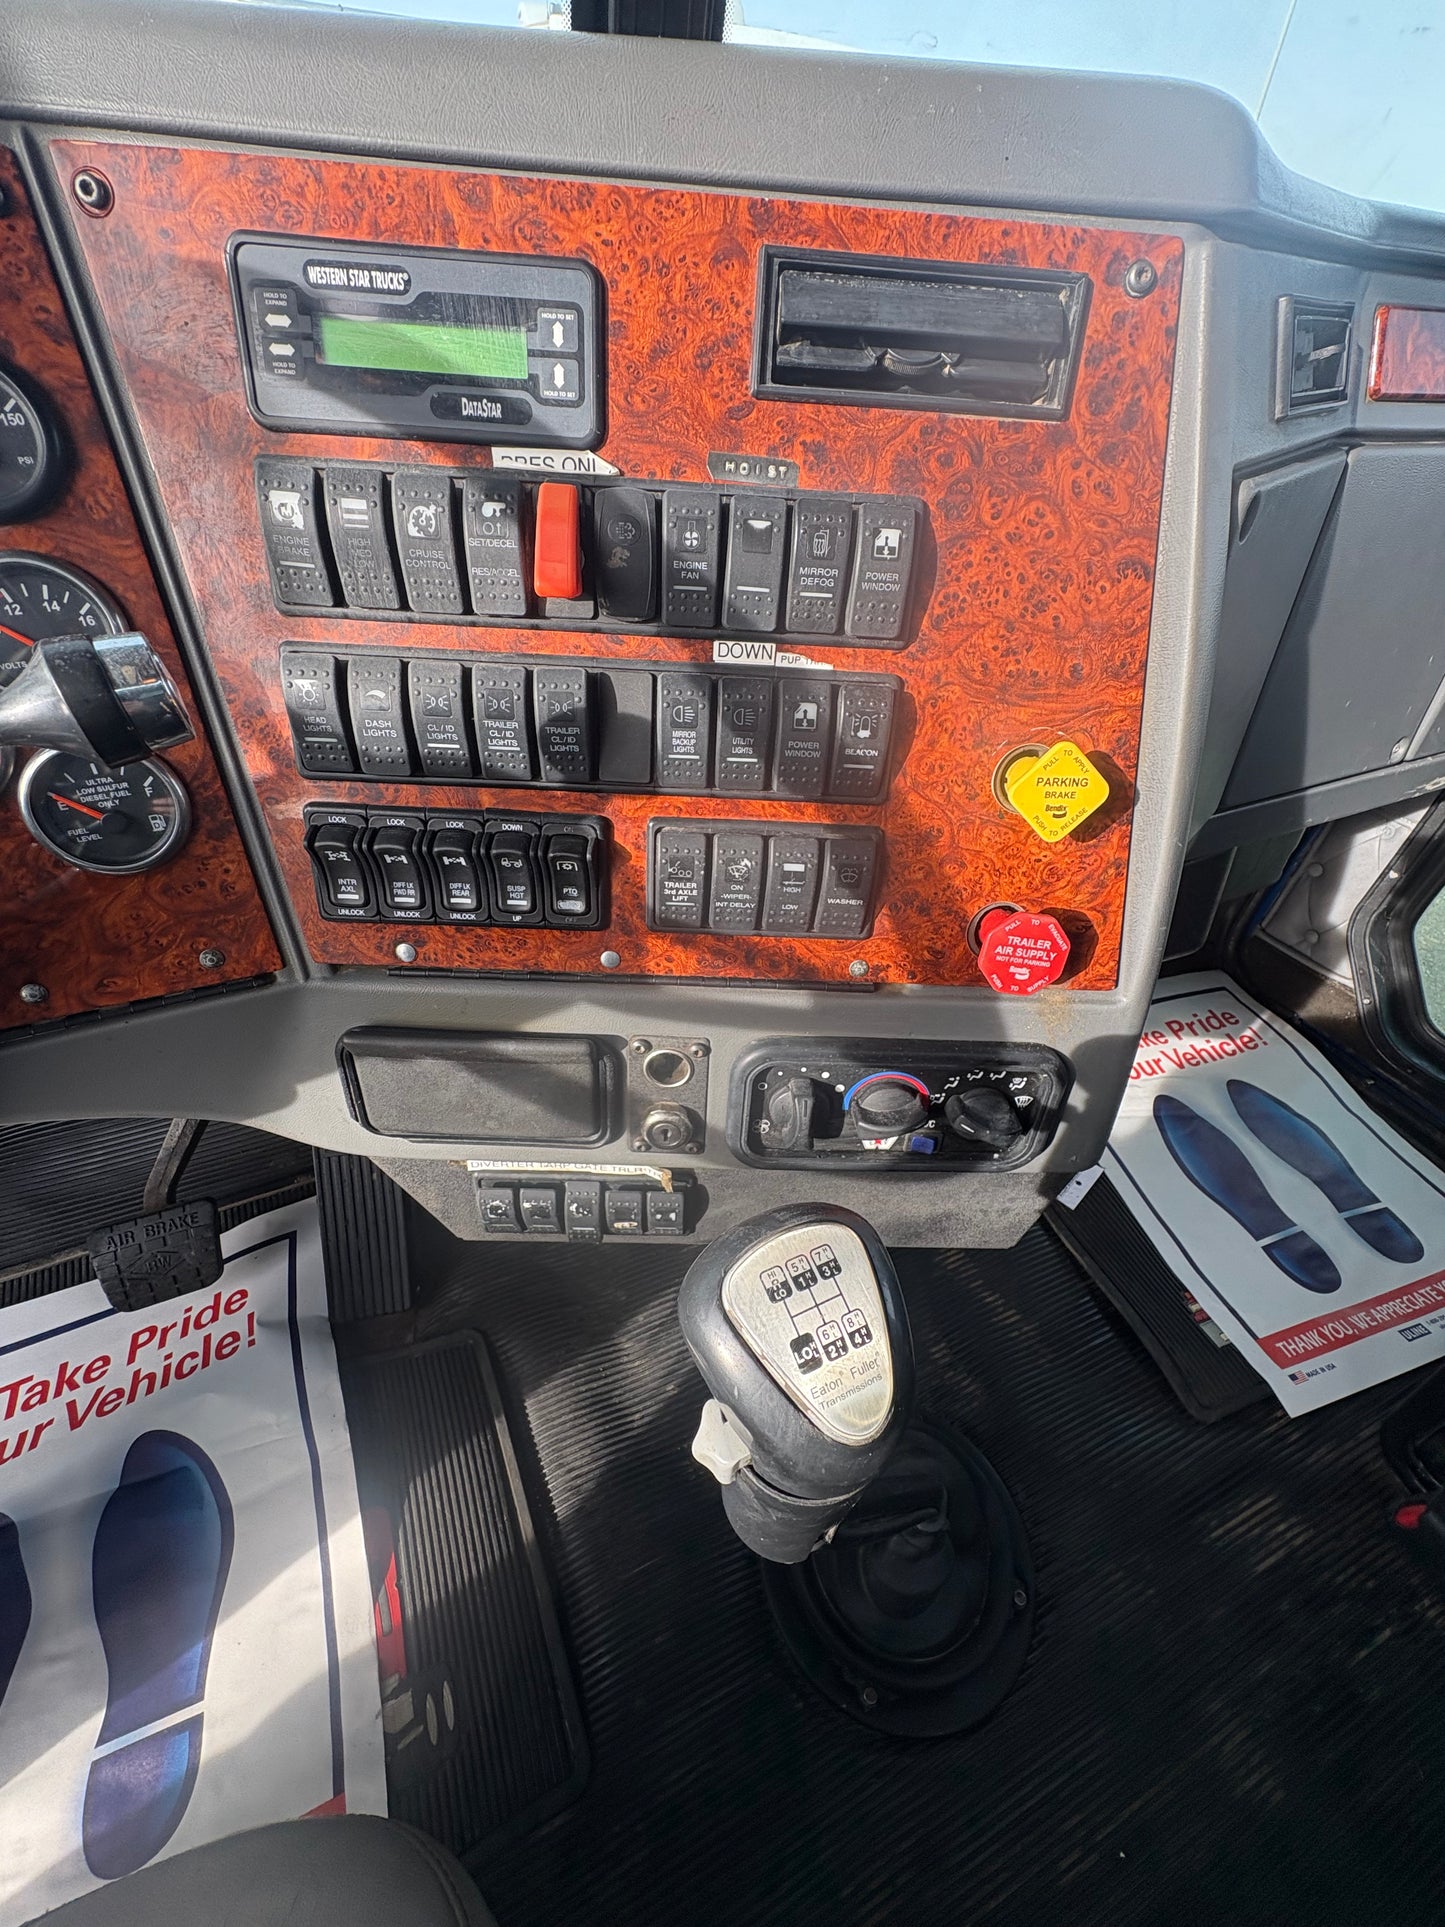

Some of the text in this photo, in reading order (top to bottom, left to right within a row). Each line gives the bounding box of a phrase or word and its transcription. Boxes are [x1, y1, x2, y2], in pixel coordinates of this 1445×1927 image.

[307, 266, 348, 286] WESTERN
[349, 269, 370, 287] STAR
[0, 413, 25, 426] 150
[725, 461, 787, 479] HOIST
[273, 535, 309, 546] ENGINE
[469, 538, 518, 548] SET/DECEL
[278, 545, 309, 556] BRAKE
[351, 549, 371, 557] MED
[409, 549, 444, 559] CRUISE
[354, 560, 375, 568] LOW
[406, 559, 451, 569] CONTROL
[673, 561, 707, 570] ENGINE
[681, 571, 699, 579] FAN
[800, 567, 838, 577] MIRROR
[866, 572, 899, 581] POWER
[801, 577, 834, 587] DEFOG
[861, 582, 900, 591] WINDOW
[4, 604, 23, 615] 12
[42, 600, 60, 612] 14
[79, 615, 96, 626] 16
[718, 643, 773, 660] DOWN
[781, 655, 801, 664] PUP
[0, 661, 27, 670] VOLTS
[365, 720, 391, 728] DASH
[483, 721, 518, 729] TRAILER
[363, 729, 397, 737] LIGHTS
[672, 731, 696, 739] MIRROR
[488, 738, 518, 746] LIGHTS
[672, 738, 696, 746] BACKUP
[788, 741, 819, 749] POWER
[732, 746, 753, 754] LIGHTS
[785, 750, 821, 758] WINDOW
[845, 748, 878, 757] BEACON
[1043, 756, 1059, 771] PULL
[1073, 757, 1089, 774] APPLY
[85, 777, 113, 786] ULTRA
[1036, 778, 1088, 787] PARKING
[76, 782, 129, 795] LOW SULFUR
[144, 787, 153, 797] F
[80, 790, 132, 803] DIESEL FUEL
[57, 802, 69, 811] E
[97, 800, 120, 808] ONLY
[1033, 815, 1047, 831] PUSH
[1060, 807, 1088, 831] RELEASE
[67, 828, 89, 836] FUEL
[76, 834, 103, 843] LEVEL
[1005, 920, 1021, 931] PULL
[1048, 924, 1068, 951] EVACUATE
[1008, 936, 1051, 949] TRAILER
[995, 946, 1057, 961] AIR SUPPLY
[1024, 959, 1050, 967] PARKING
[991, 974, 1003, 988] PUSH
[1027, 976, 1049, 992] SUPPLY
[1165, 1009, 1240, 1040] Pride
[1160, 1026, 1269, 1070] Vehicle!
[105, 1211, 200, 1250] AIR BRAKE
[815, 1252, 821, 1261] 7
[791, 1263, 799, 1273] 5
[822, 1267, 831, 1276] 3
[767, 1271, 776, 1280] HI
[798, 1278, 806, 1287] 1
[774, 1290, 787, 1300] LO
[847, 1318, 854, 1327] 8
[1275, 1329, 1327, 1358] THANK
[1319, 1319, 1358, 1342] YOU,
[1349, 1312, 1378, 1330] WE
[1371, 1286, 1443, 1325] APPRECIATE
[822, 1329, 829, 1340] 6
[1401, 1324, 1429, 1340] ULINE
[854, 1334, 861, 1345] 4
[0, 1288, 249, 1421] Take Pride
[795, 1347, 813, 1364] LO
[829, 1346, 838, 1357] 2
[66, 1311, 257, 1431] Vehicle!
[1325, 1363, 1337, 1371] USA
[819, 1373, 883, 1410] Transmissions
